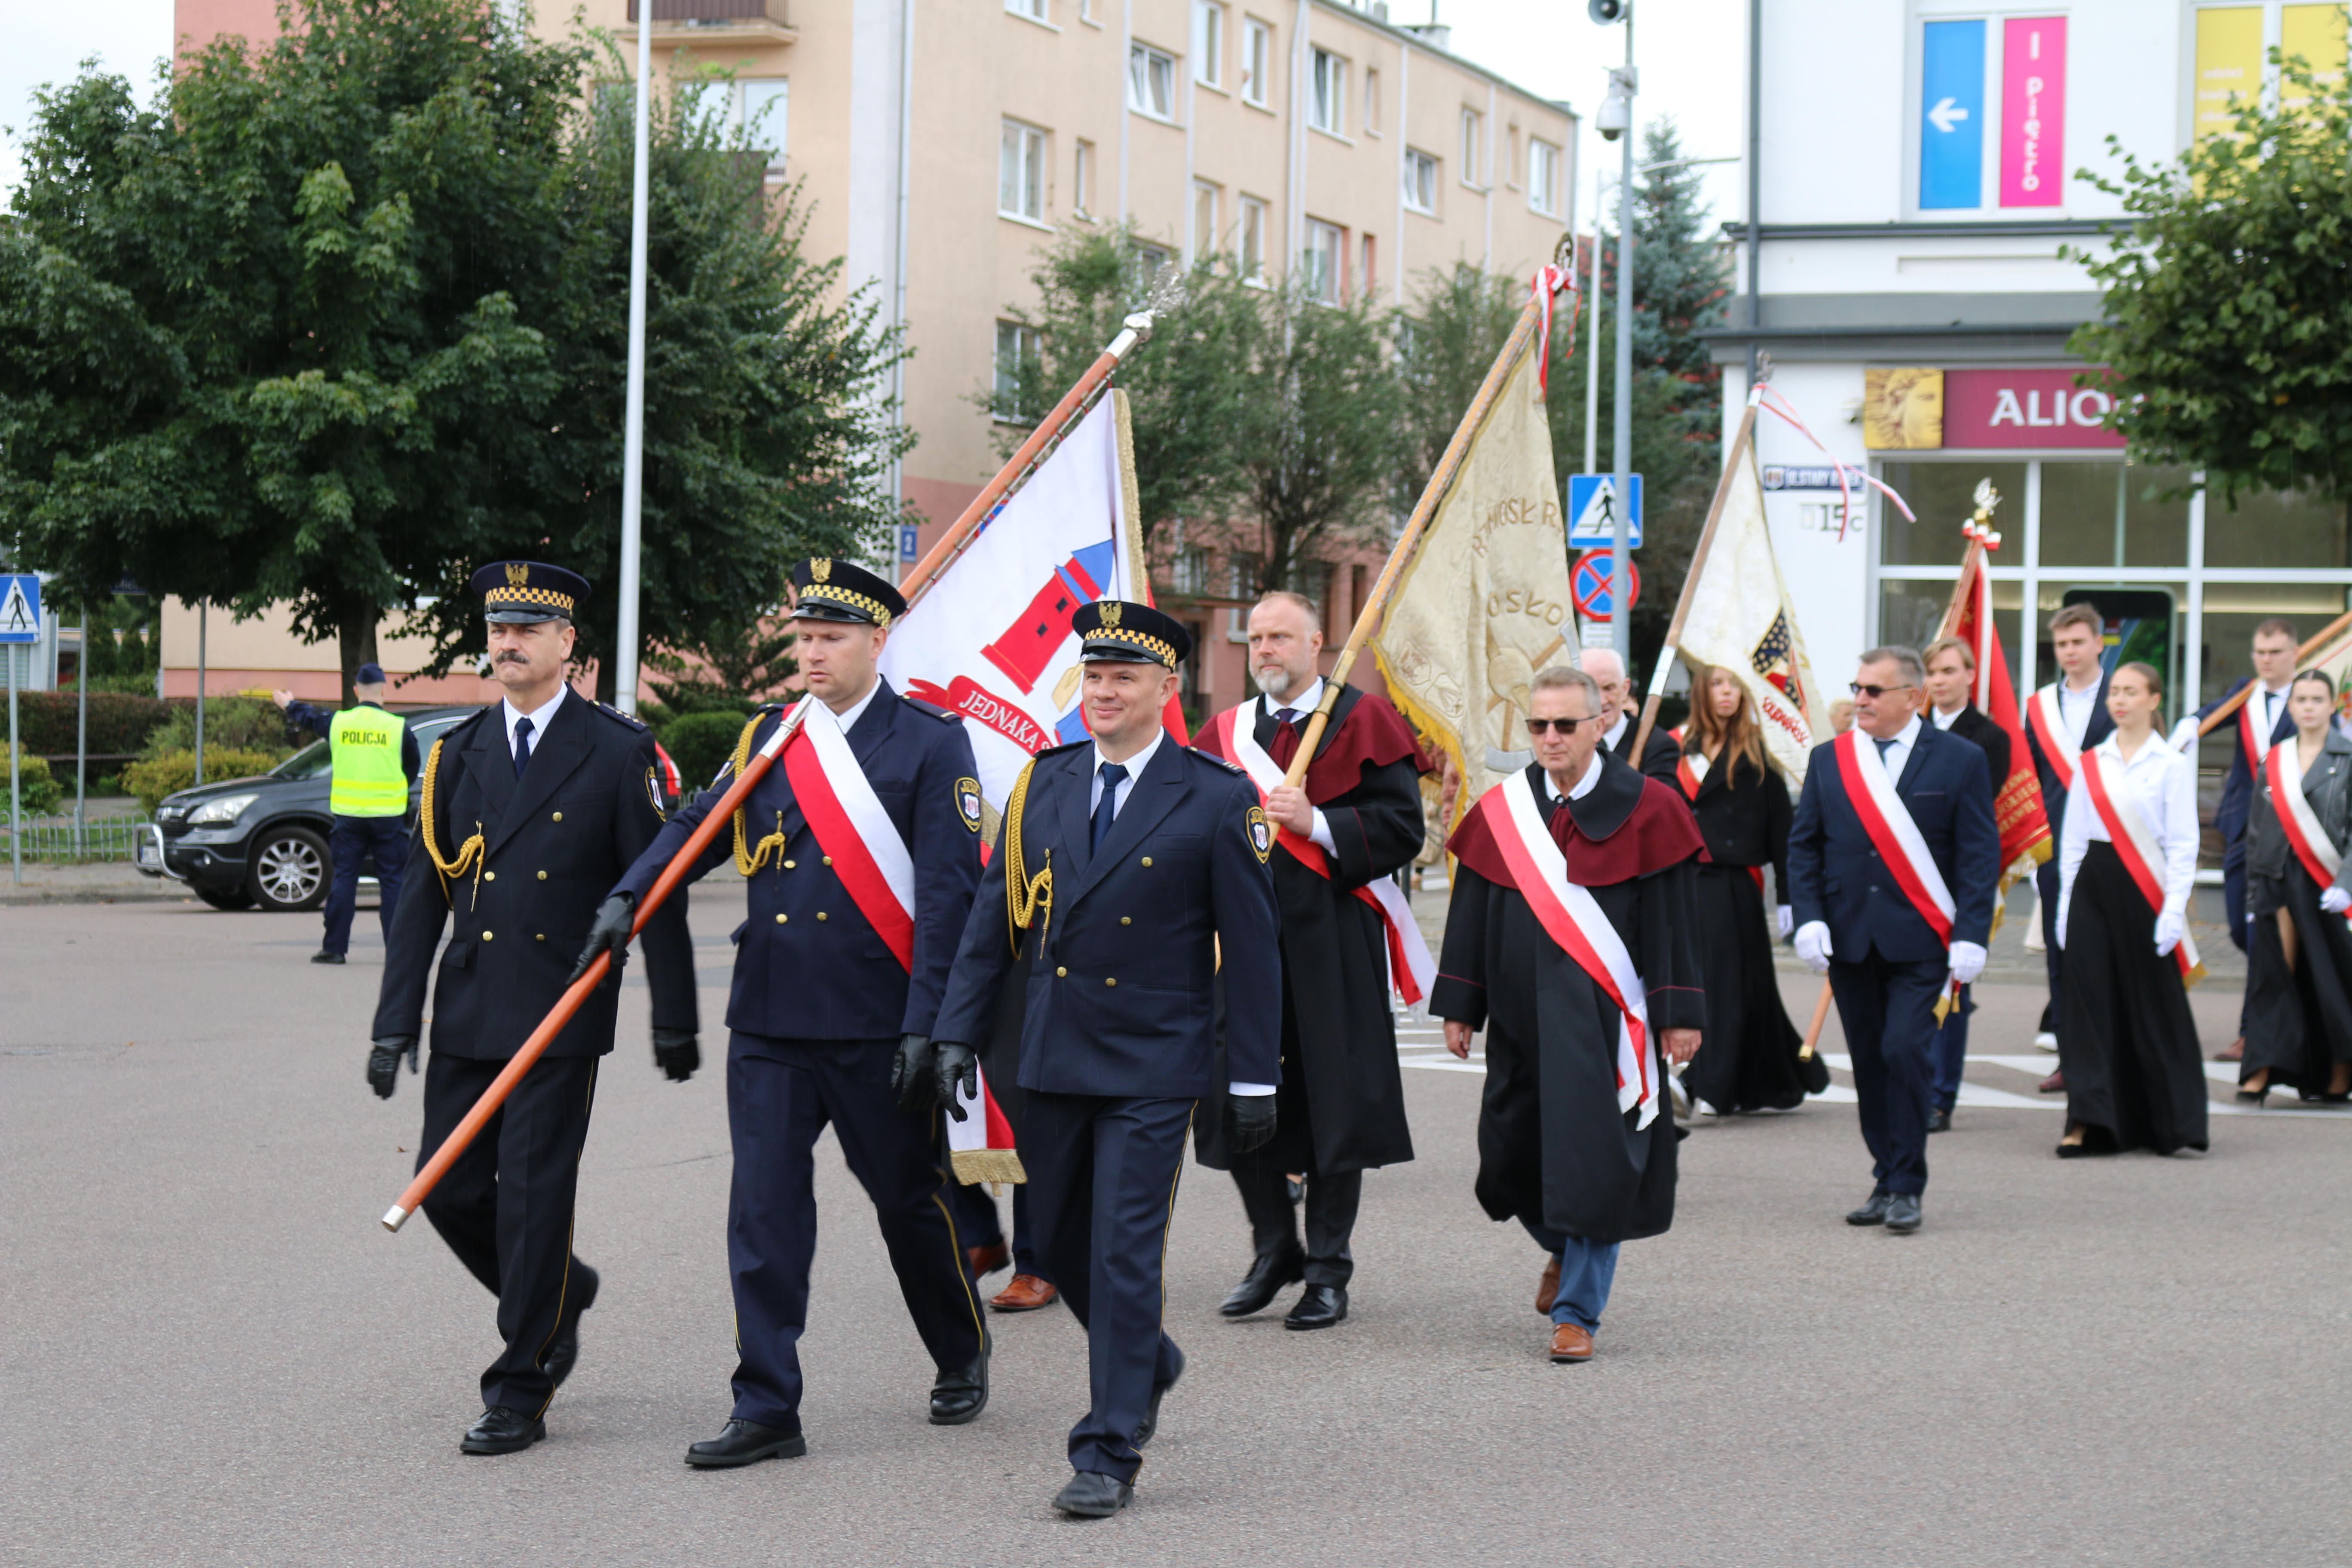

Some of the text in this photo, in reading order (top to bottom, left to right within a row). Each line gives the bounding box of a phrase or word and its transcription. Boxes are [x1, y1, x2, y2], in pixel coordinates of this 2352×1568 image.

[904, 534, 913, 552] 2
[959, 690, 1039, 750] JEDNAKA
[342, 731, 387, 747] POLICJA
